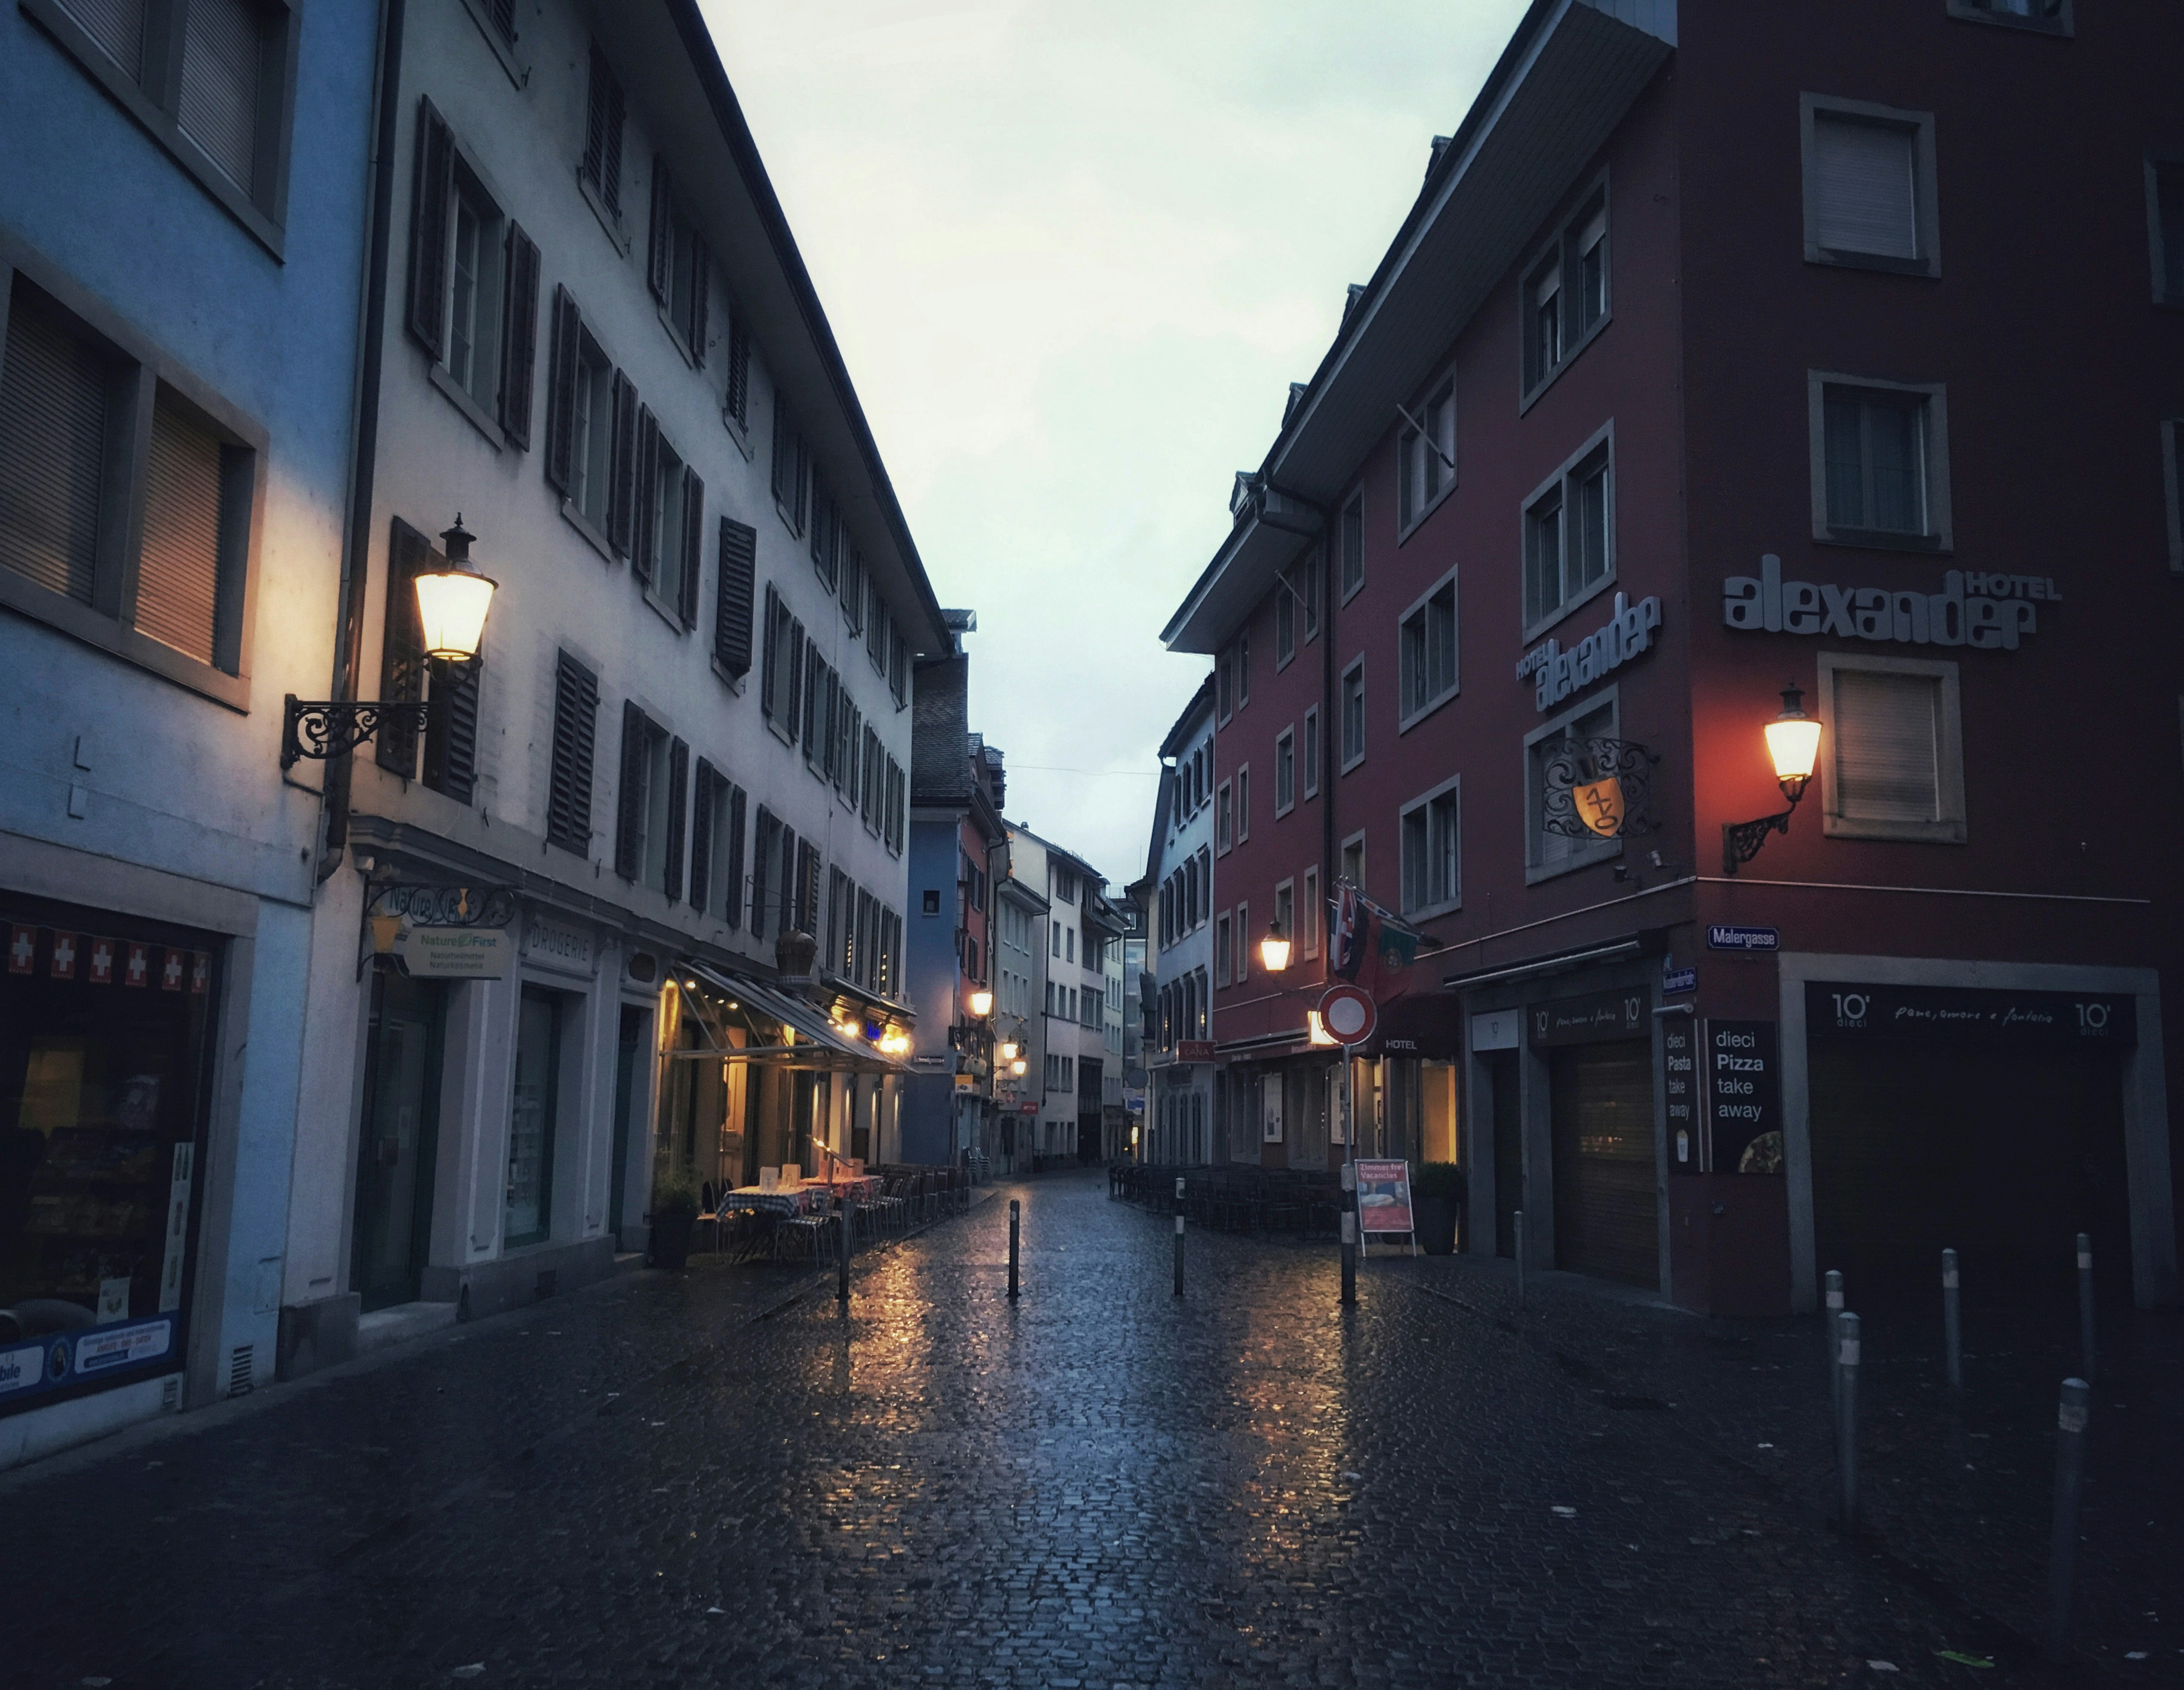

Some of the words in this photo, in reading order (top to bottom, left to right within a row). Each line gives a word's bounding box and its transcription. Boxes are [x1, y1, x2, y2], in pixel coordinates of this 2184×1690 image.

[1965, 571, 2062, 601] HOTEL
[1724, 554, 2036, 650] alexander
[1536, 592, 1661, 712] alexander
[1516, 643, 1549, 681] HOTEL
[421, 934, 458, 947] Nature
[472, 936, 497, 947] First
[531, 922, 589, 962] DROGERIE
[1713, 928, 1775, 948] Malergasse
[430, 952, 485, 961] Naturheilmittel
[429, 961, 484, 970] Naturkosmetik
[1836, 1018, 1867, 1028] dieci
[2079, 1027, 2109, 1036] dieci
[1386, 1039, 1417, 1050] HOTEL
[1667, 1033, 1686, 1049] dieci
[1716, 1031, 1755, 1048] dieci
[1668, 1055, 1692, 1071] Pasta
[1717, 1053, 1764, 1071] Pizza
[1669, 1077, 1686, 1094] take
[1717, 1077, 1754, 1095] take
[1669, 1104, 1690, 1121] away
[1718, 1104, 1762, 1122] away
[0, 1364, 21, 1382] bile
